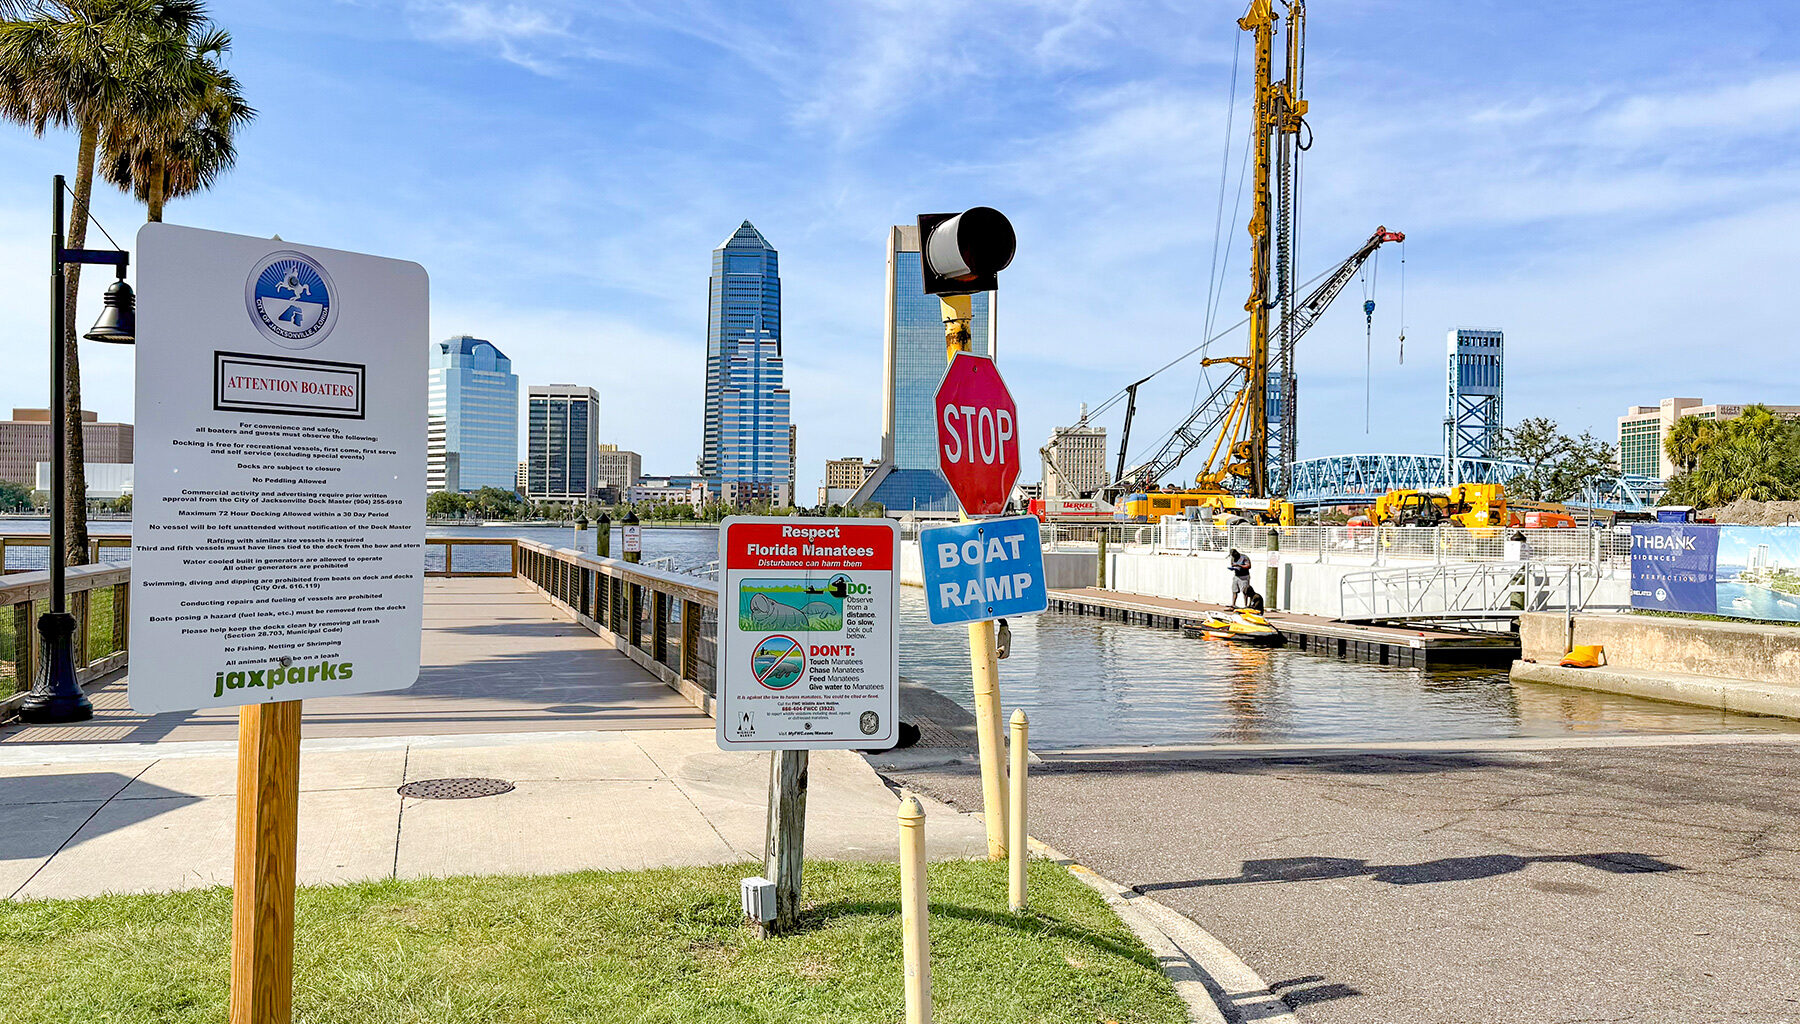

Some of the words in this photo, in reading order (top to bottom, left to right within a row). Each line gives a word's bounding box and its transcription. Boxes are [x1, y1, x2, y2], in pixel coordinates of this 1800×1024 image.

[257, 299, 265, 314] CITY
[263, 314, 270, 323] OF
[314, 307, 328, 331] FLORIDA
[228, 376, 298, 393] ATTENTION
[301, 382, 354, 397] BOATERS
[943, 404, 1013, 464] STOP
[782, 526, 840, 540] Respect
[747, 544, 797, 556] Florida
[802, 544, 874, 557] Manatees
[937, 534, 1024, 568] BOAT
[274, 576, 311, 584] prohibited
[848, 583, 871, 595] DO:
[939, 573, 1032, 608] RAMP
[810, 645, 855, 656] DON'T:
[214, 661, 353, 697] jaxparks
